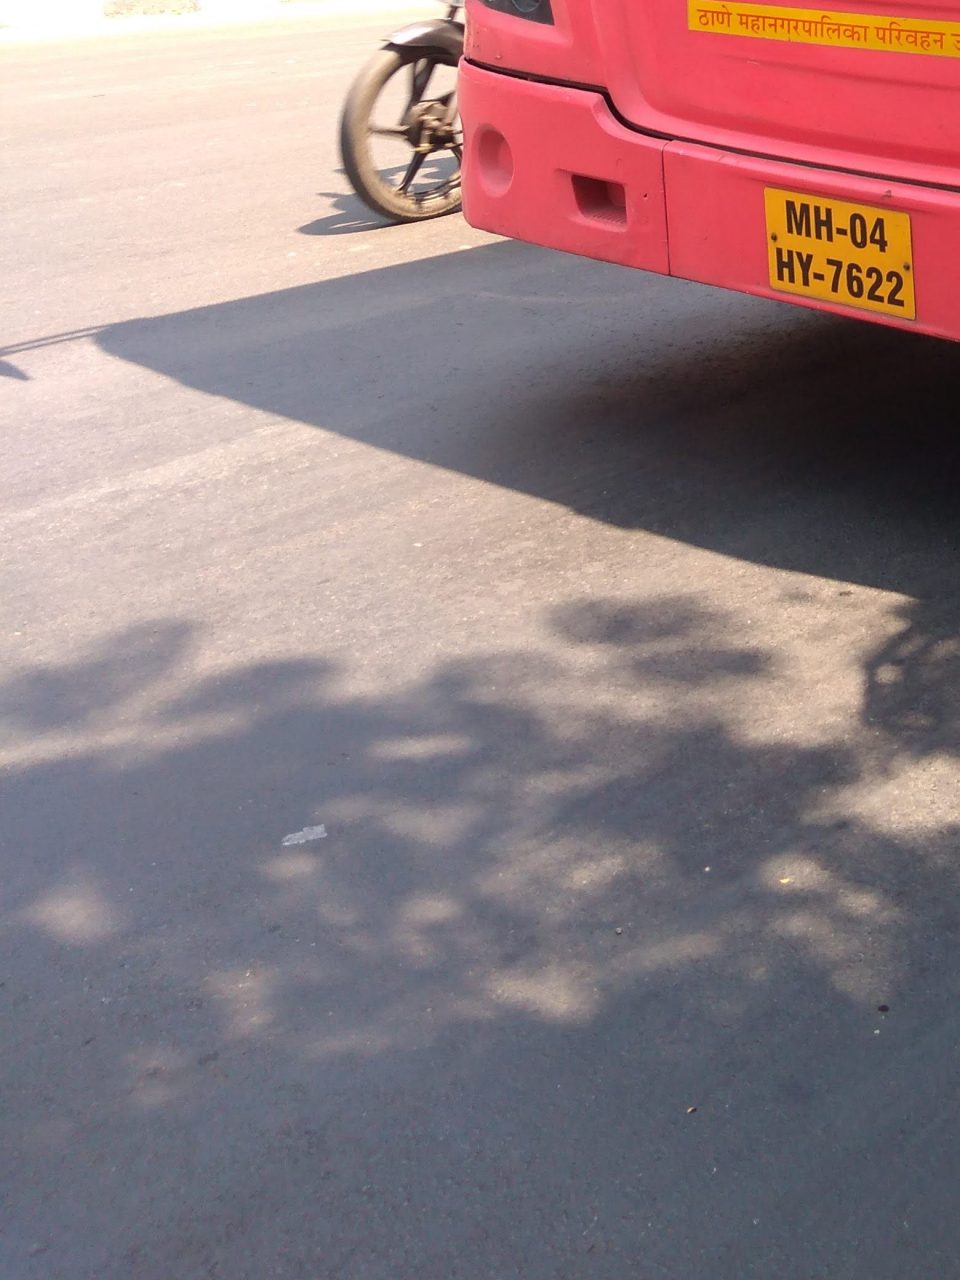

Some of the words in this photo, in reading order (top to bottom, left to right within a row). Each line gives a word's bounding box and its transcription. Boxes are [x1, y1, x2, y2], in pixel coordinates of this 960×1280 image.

[697, 4, 732, 28] ठाणे
[736, 13, 870, 43] महानगरपालिका
[874, 21, 946, 51] परिवहन
[785, 200, 888, 253] MH-04
[775, 247, 905, 307] HY-7622
